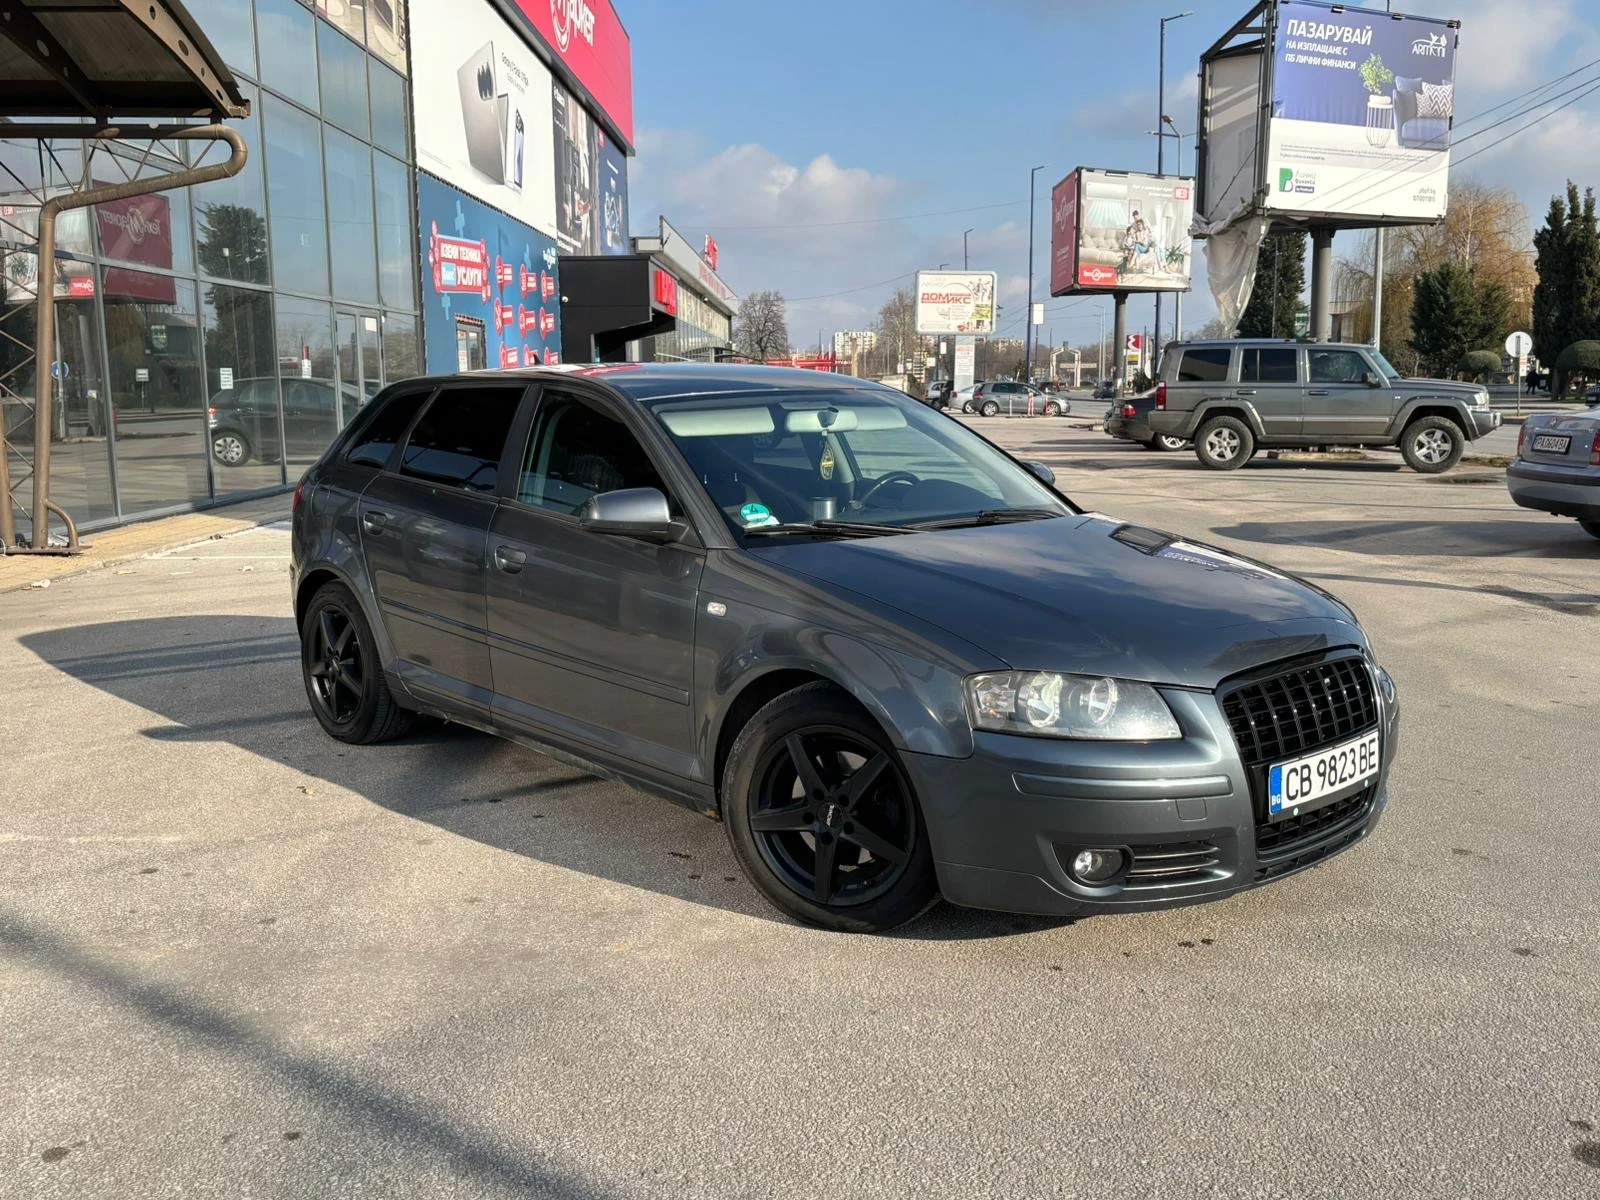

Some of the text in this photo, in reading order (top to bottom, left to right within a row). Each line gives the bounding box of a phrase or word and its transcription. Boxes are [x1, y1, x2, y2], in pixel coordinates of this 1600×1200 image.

[1286, 19, 1373, 46] ПАЗАРУВАЙ
[1286, 40, 1348, 56] НА ИЗПЛАЩАНЕ С
[1285, 54, 1356, 70] ПБ ЛИЧНИ ФИНАНСИ
[921, 292, 972, 305] ДОМИКС
[1286, 738, 1376, 801] CB 9823 BE
[1272, 794, 1281, 806] BG
